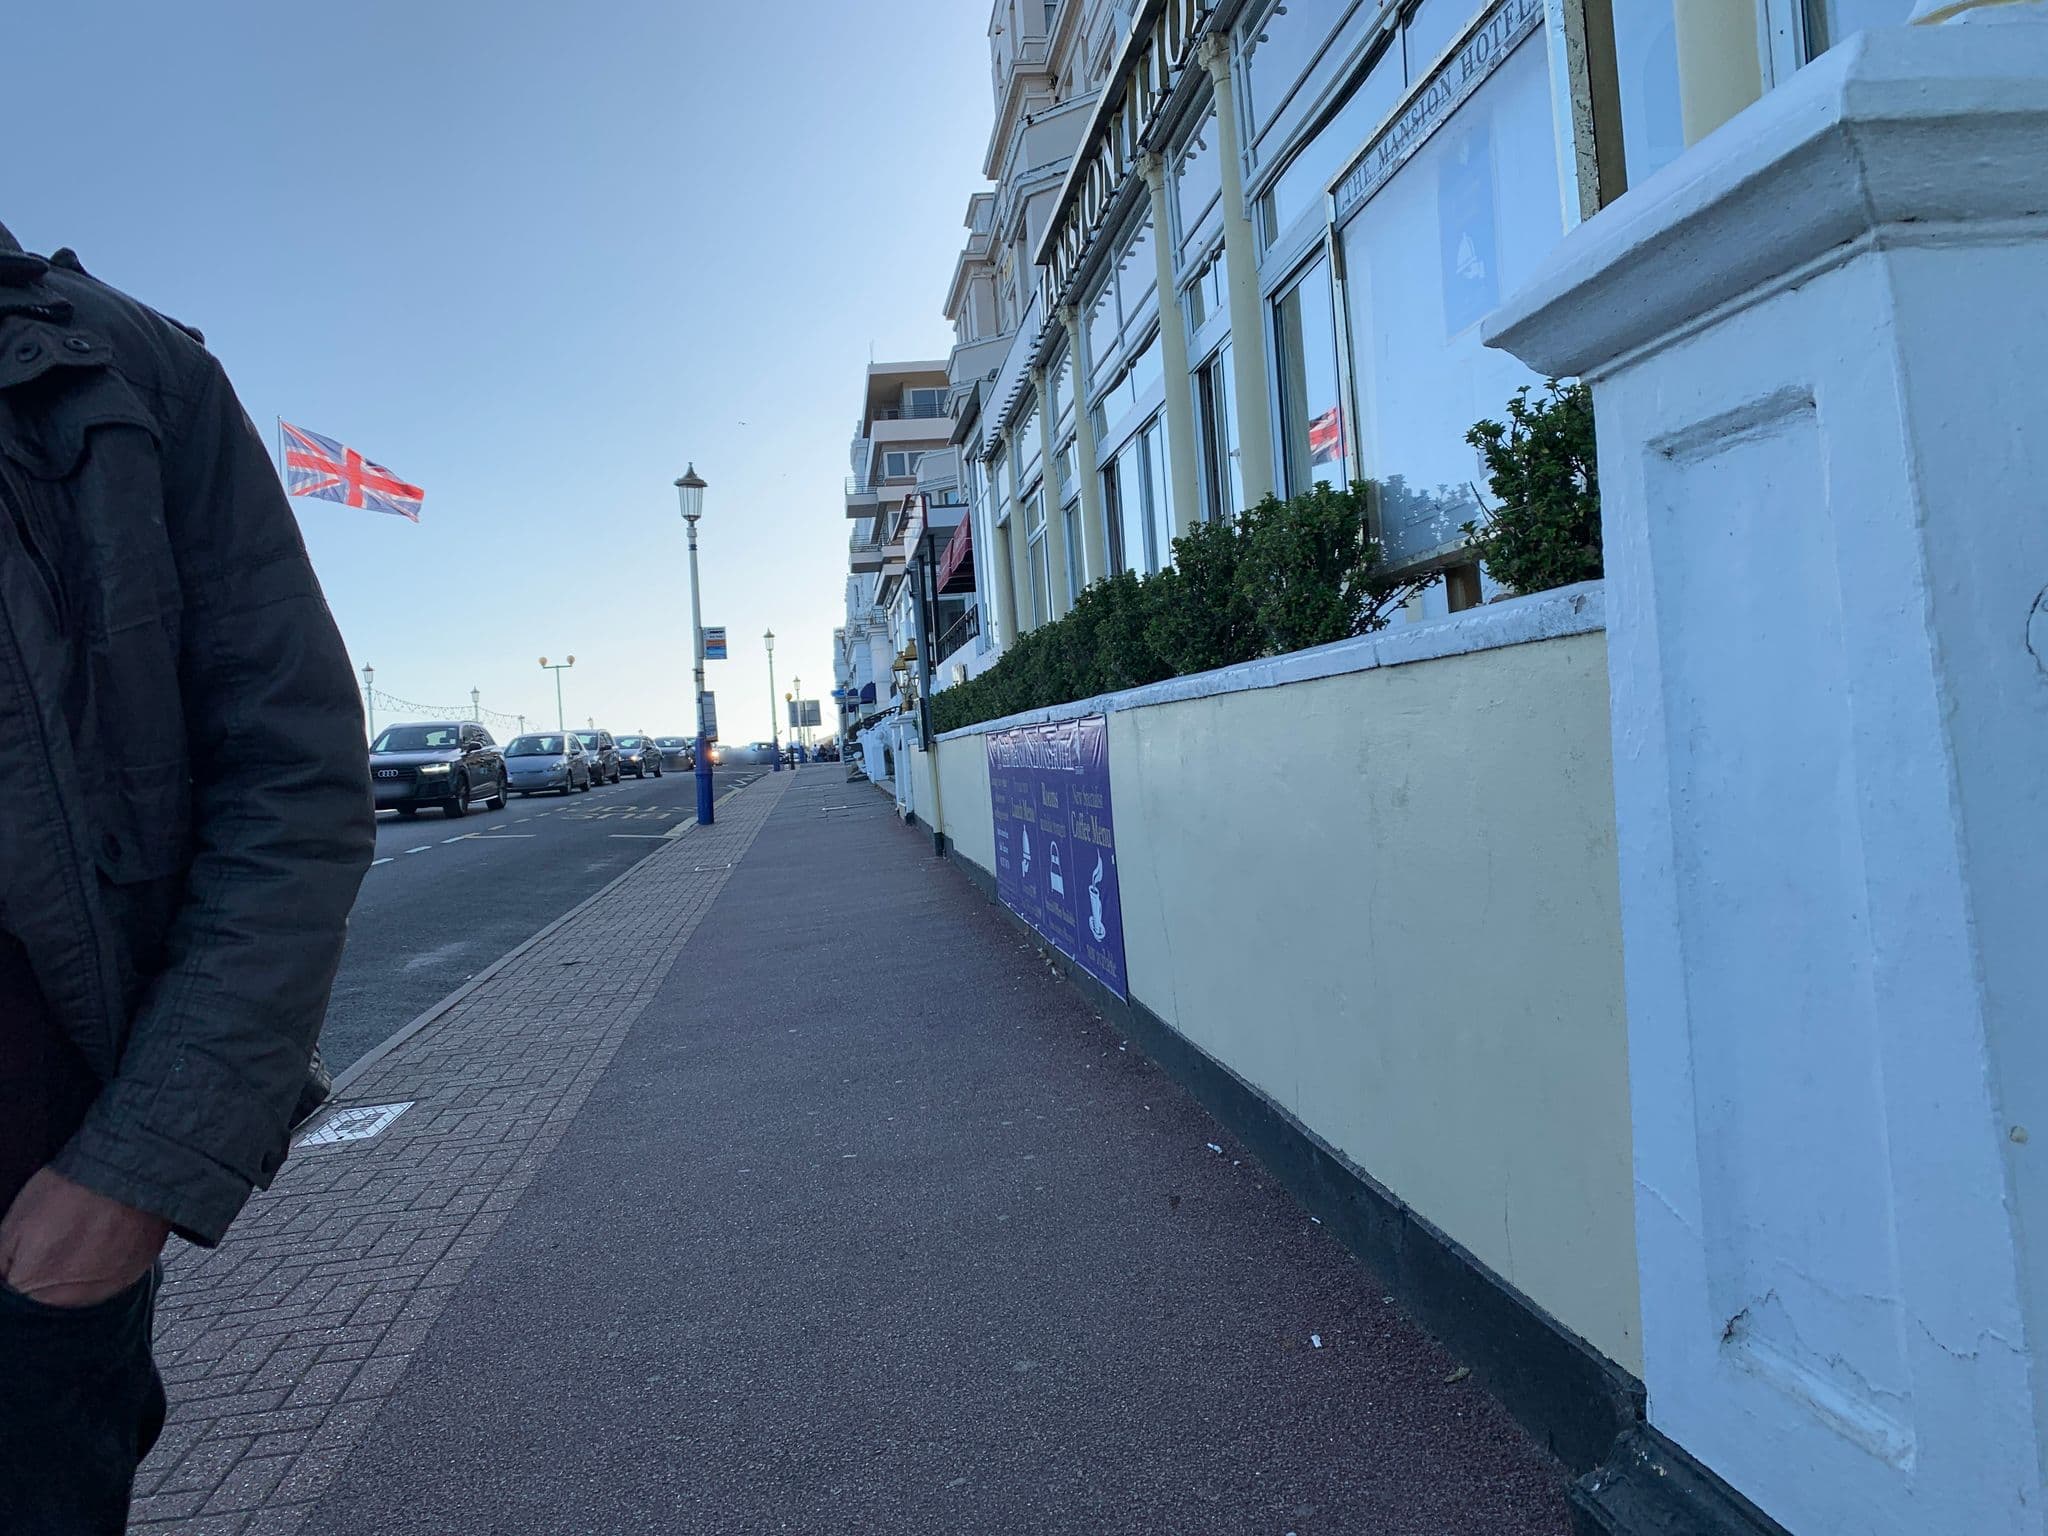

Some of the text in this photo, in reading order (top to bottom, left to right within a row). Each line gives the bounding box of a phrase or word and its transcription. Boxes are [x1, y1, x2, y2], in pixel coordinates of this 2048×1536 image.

[1342, 0, 1537, 205] THE MANSION HOTEL
[1071, 810, 1091, 842] Coffee
[1091, 815, 1113, 848] Menu
